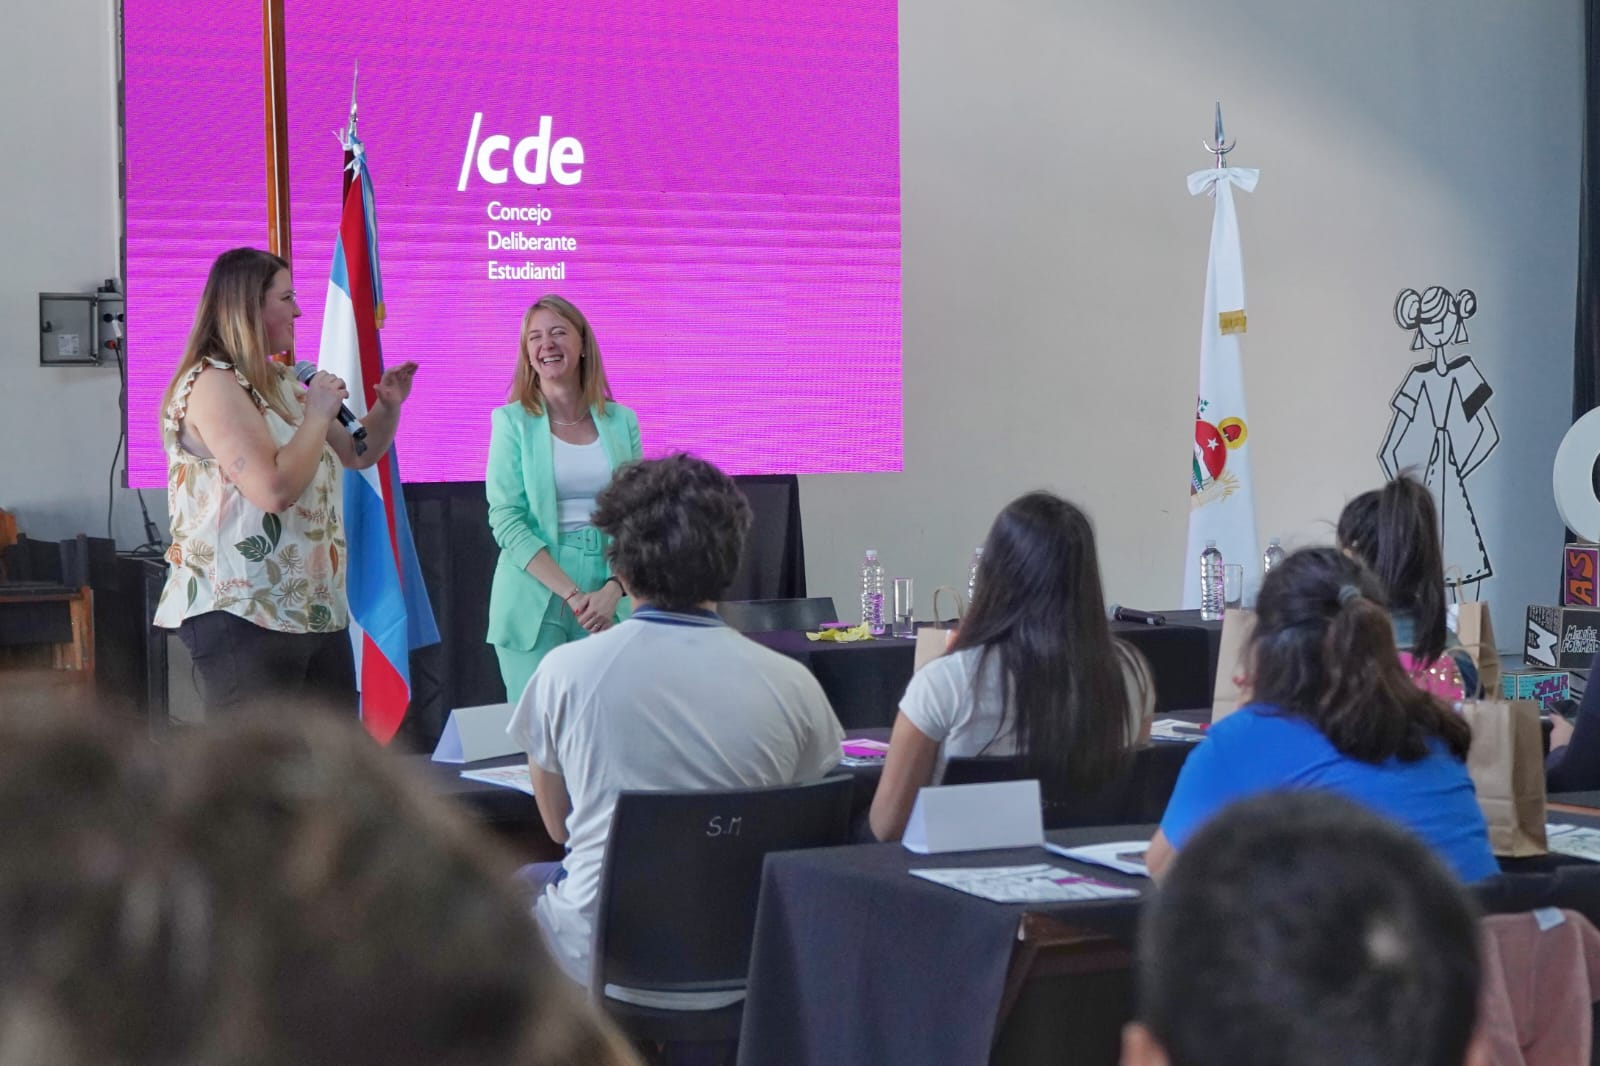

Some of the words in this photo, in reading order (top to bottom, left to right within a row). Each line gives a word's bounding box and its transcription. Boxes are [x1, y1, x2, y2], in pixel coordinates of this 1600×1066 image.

[487, 201, 552, 226] Concejo
[487, 230, 577, 251] Deliberante
[488, 261, 566, 280] Estudiantil
[1569, 551, 1593, 605] AS
